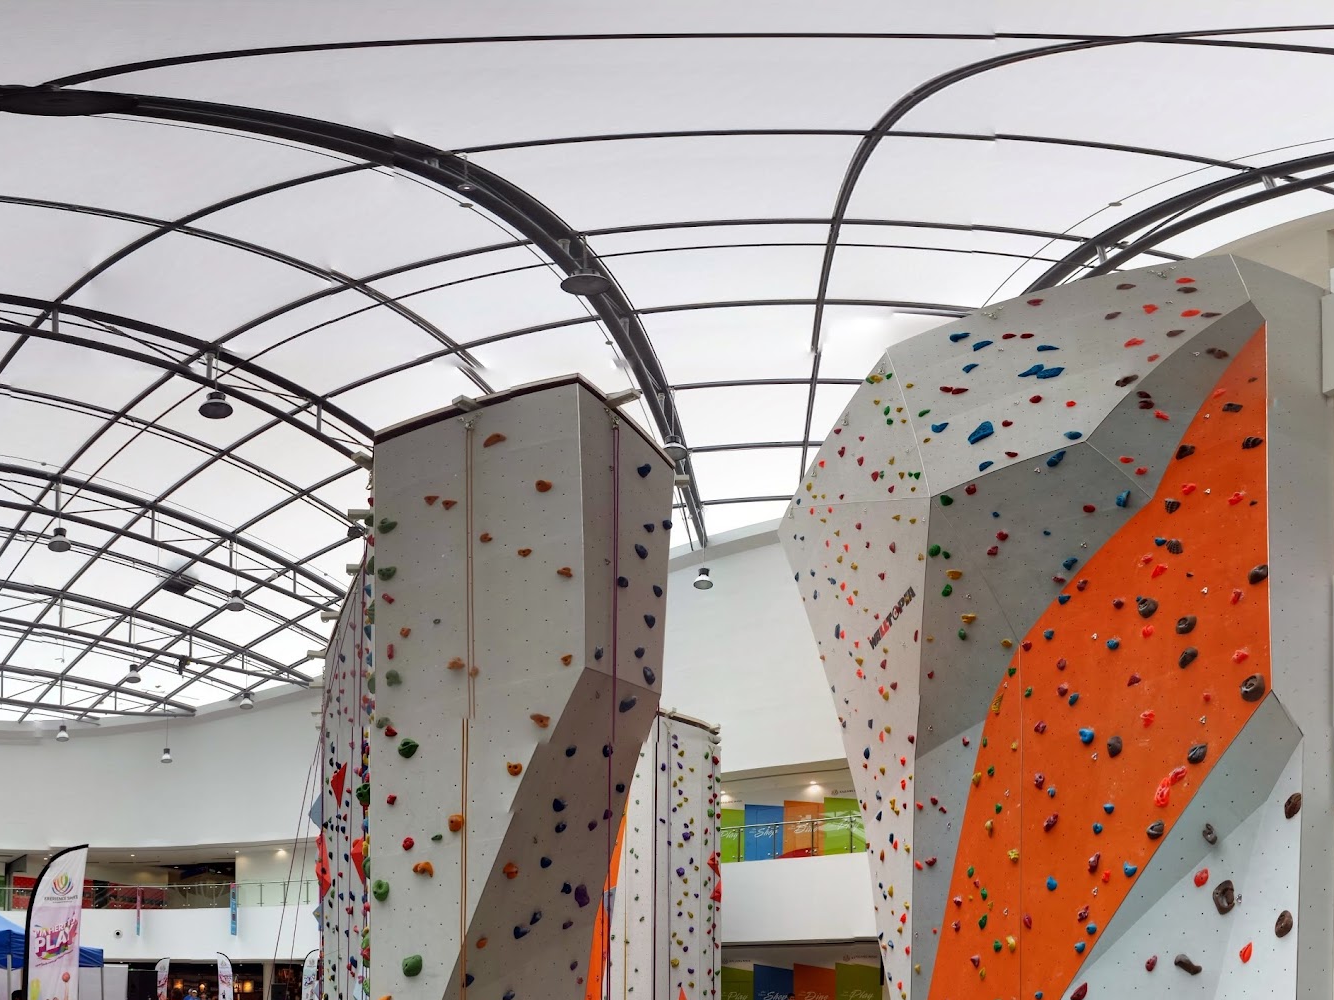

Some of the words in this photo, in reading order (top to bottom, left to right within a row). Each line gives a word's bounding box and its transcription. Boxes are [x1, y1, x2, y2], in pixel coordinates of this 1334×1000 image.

[35, 924, 75, 953] PLAY
[805, 991, 829, 1000] Dine
[849, 989, 873, 1000] Play
